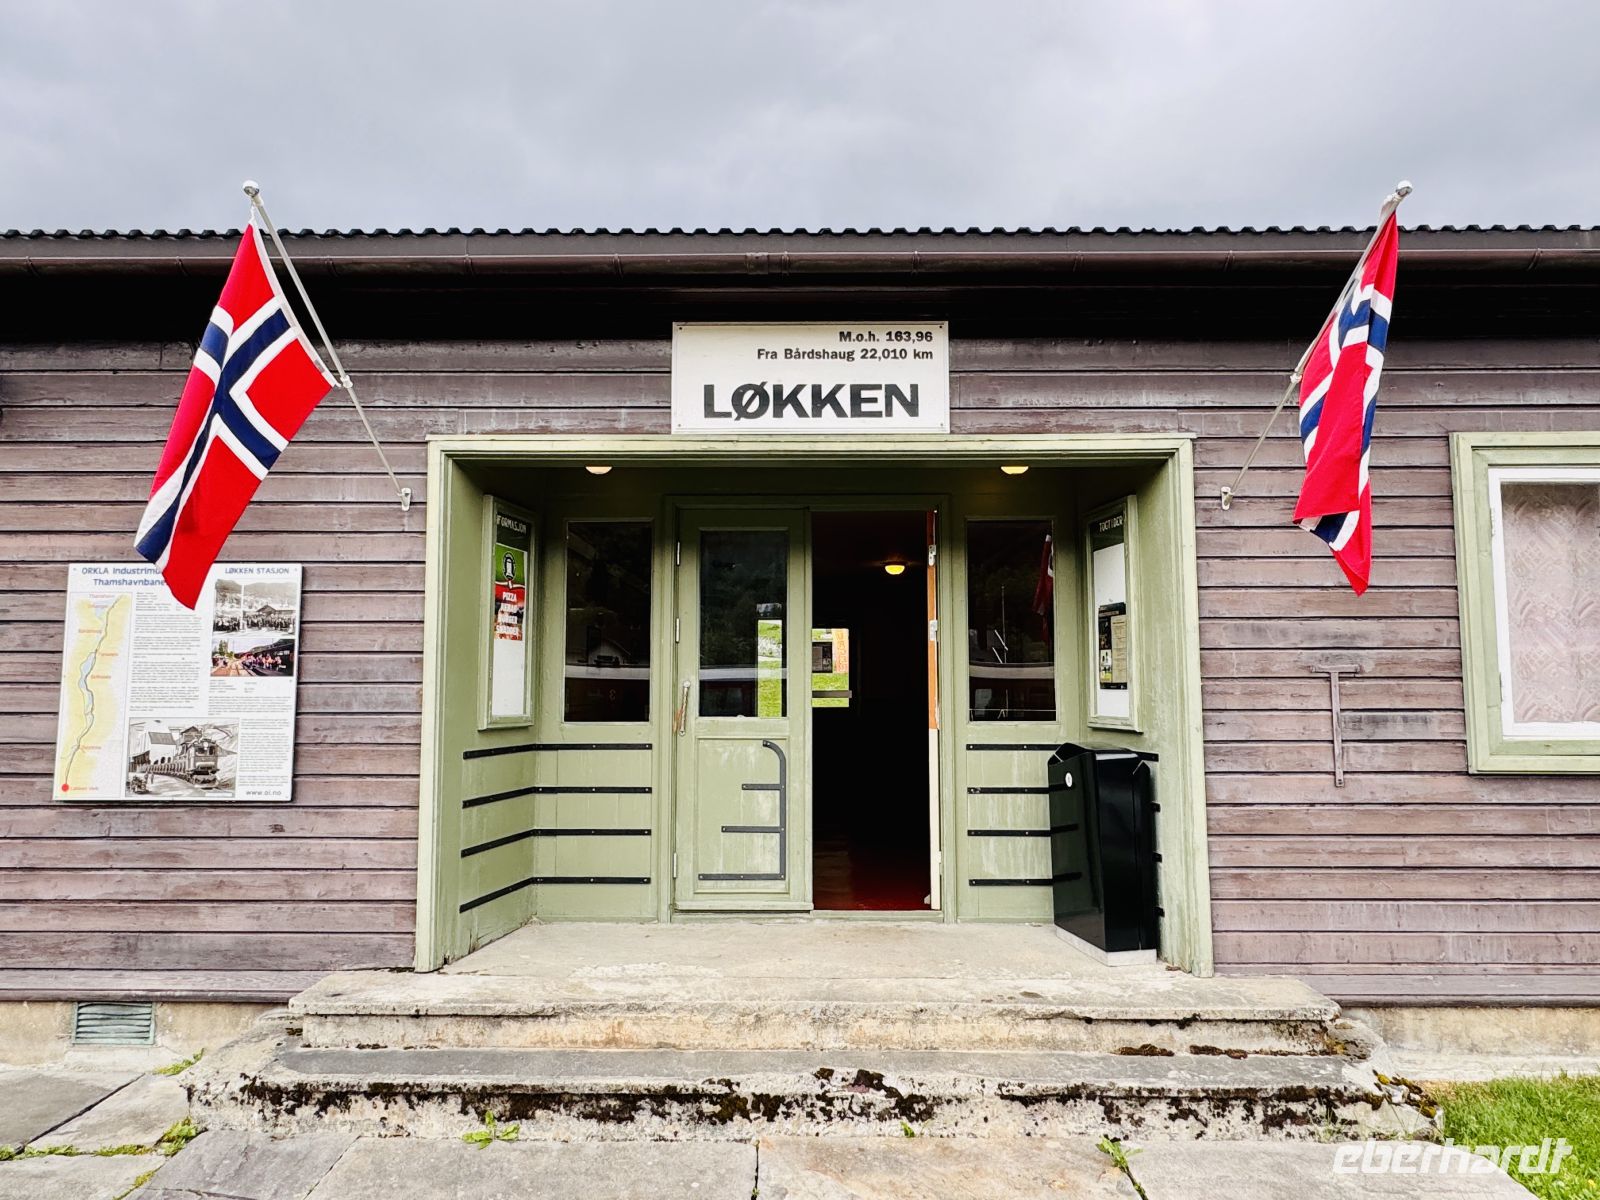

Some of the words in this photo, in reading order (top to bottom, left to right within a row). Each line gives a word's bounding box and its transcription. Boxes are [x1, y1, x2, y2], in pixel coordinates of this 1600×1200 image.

[838, 331, 880, 342] M.o.h.
[885, 331, 933, 343] 163,96
[757, 349, 778, 360] Fra
[784, 347, 855, 362] Bårdshaug
[860, 348, 908, 361] 22,010
[913, 349, 933, 360] km
[703, 381, 919, 421] LØKKEN
[81, 567, 109, 575] ORKLA
[112, 567, 161, 575] Industrimu
[93, 578, 166, 586] Thamshavnbane
